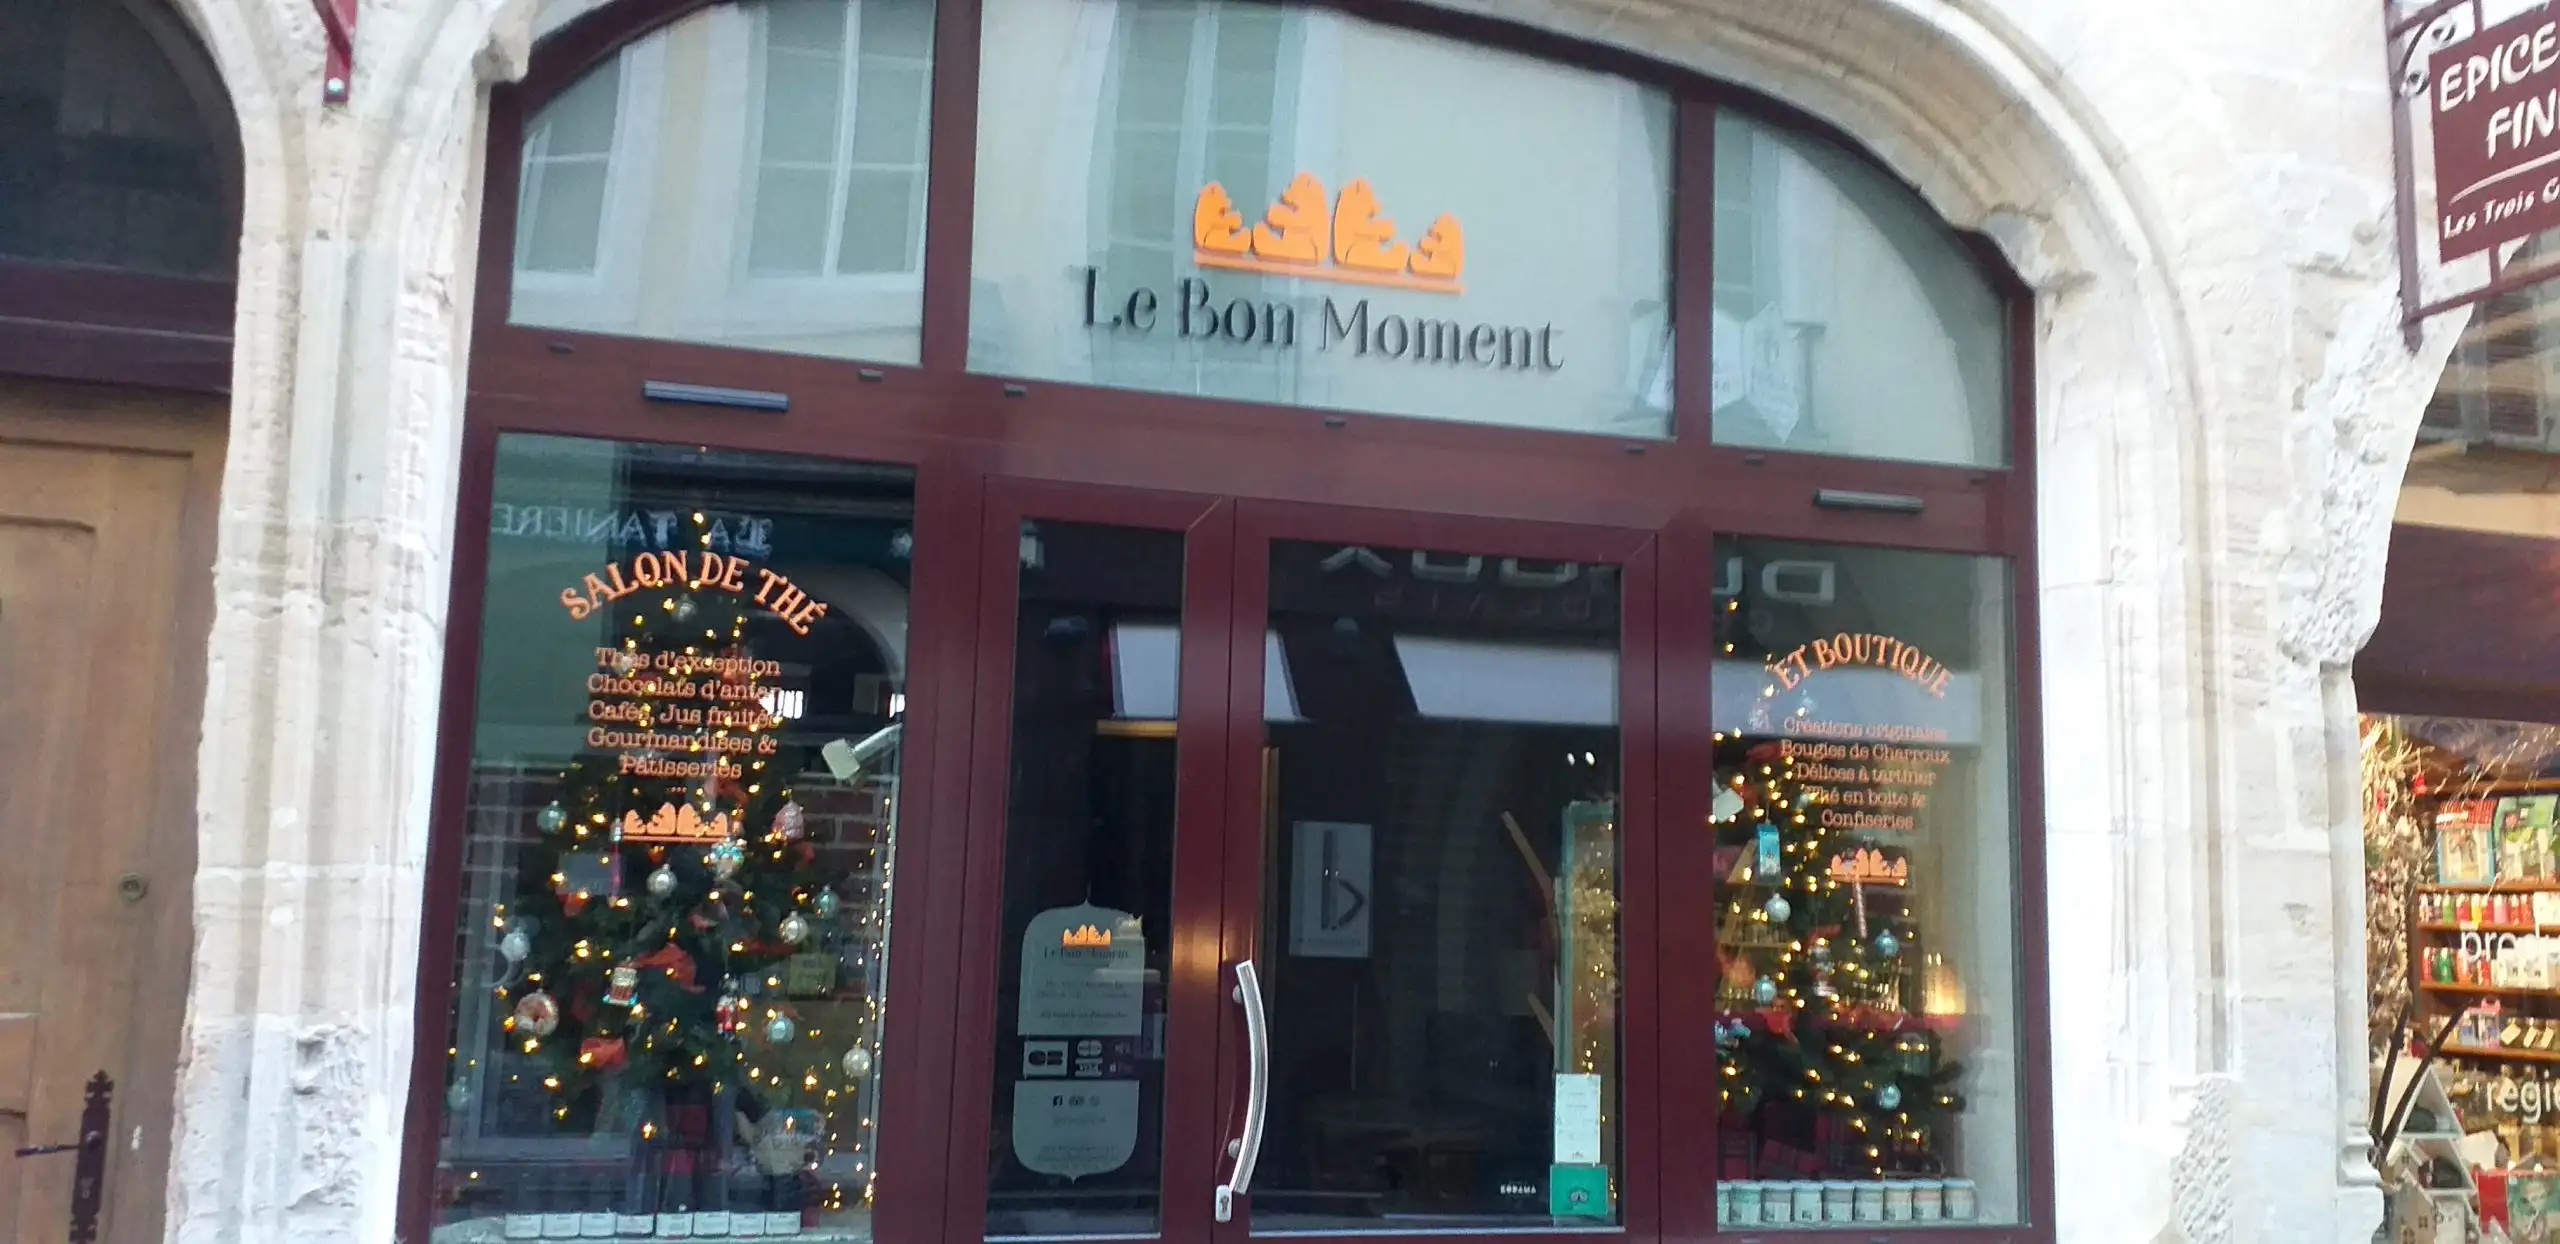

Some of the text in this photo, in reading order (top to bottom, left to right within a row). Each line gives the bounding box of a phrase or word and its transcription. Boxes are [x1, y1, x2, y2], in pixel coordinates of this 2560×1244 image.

[2487, 87, 2560, 160] FIN
[2444, 210, 2477, 239] Les
[2483, 190, 2535, 225] Trois
[1080, 266, 1564, 372] Le Bon Moment
[560, 550, 828, 636] SALON DE THÉ
[654, 650, 782, 678] d'exception
[1773, 632, 1954, 700] ET BOUTIQUE
[587, 673, 696, 700] Chocolats
[659, 704, 702, 726] Jus
[1783, 716, 1863, 740] Créations
[587, 727, 778, 756] Gourmandises &
[1780, 738, 1951, 767] Bougies de Charroux
[618, 752, 743, 779] Pâtisseries
[1796, 763, 1938, 787] Délices à tartiner
[1842, 791, 1867, 807] en
[1821, 808, 1916, 830] Confiseries
